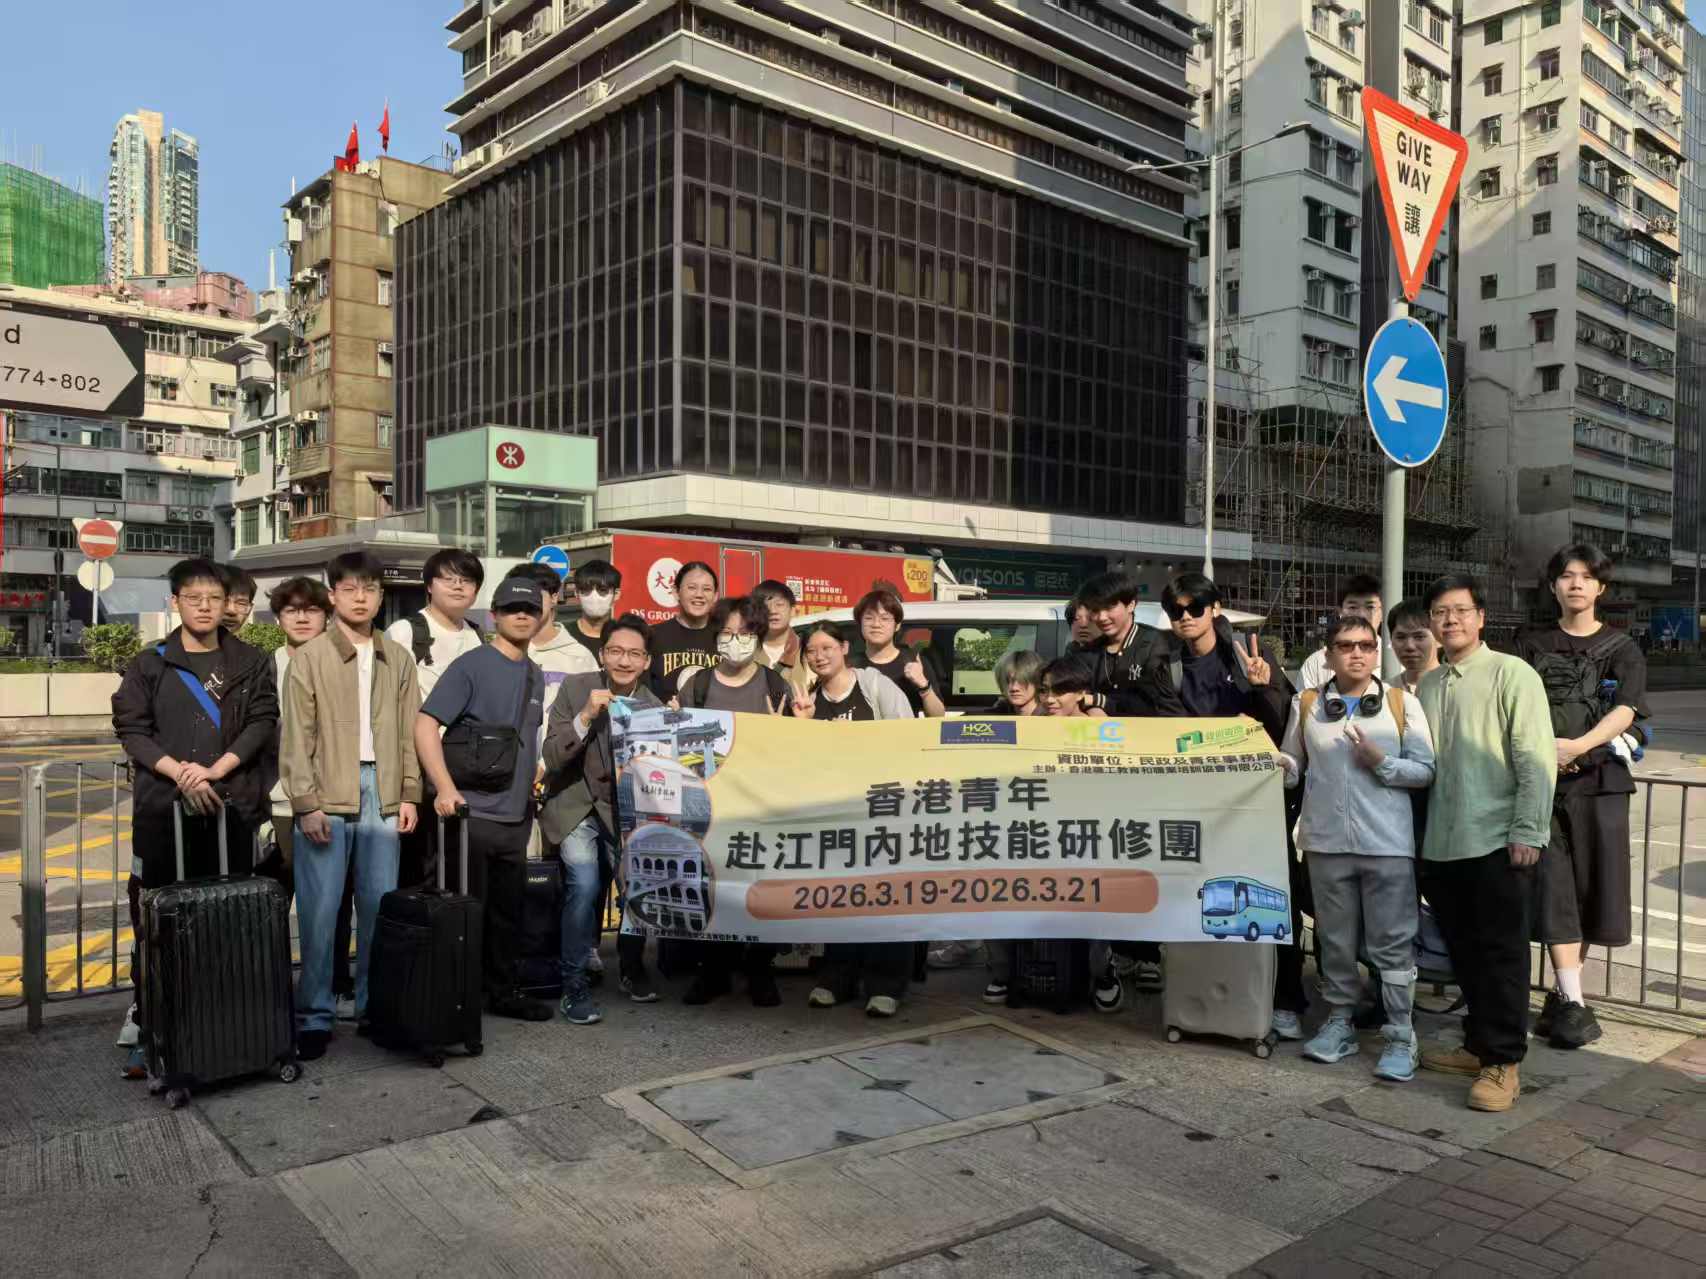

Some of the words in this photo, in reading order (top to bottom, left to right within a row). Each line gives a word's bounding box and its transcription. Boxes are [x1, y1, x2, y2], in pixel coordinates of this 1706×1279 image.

[1396, 131, 1432, 168] GIVE
[1397, 160, 1431, 195] WAY
[1404, 202, 1421, 237] 讓
[3, 365, 101, 393] 774-802
[663, 651, 724, 677] HERITAG
[865, 776, 1050, 819] 香港青年
[725, 818, 1201, 870] 赴江門內地技能研修團
[793, 877, 1101, 910] 2026.3.19-2026.3.21
